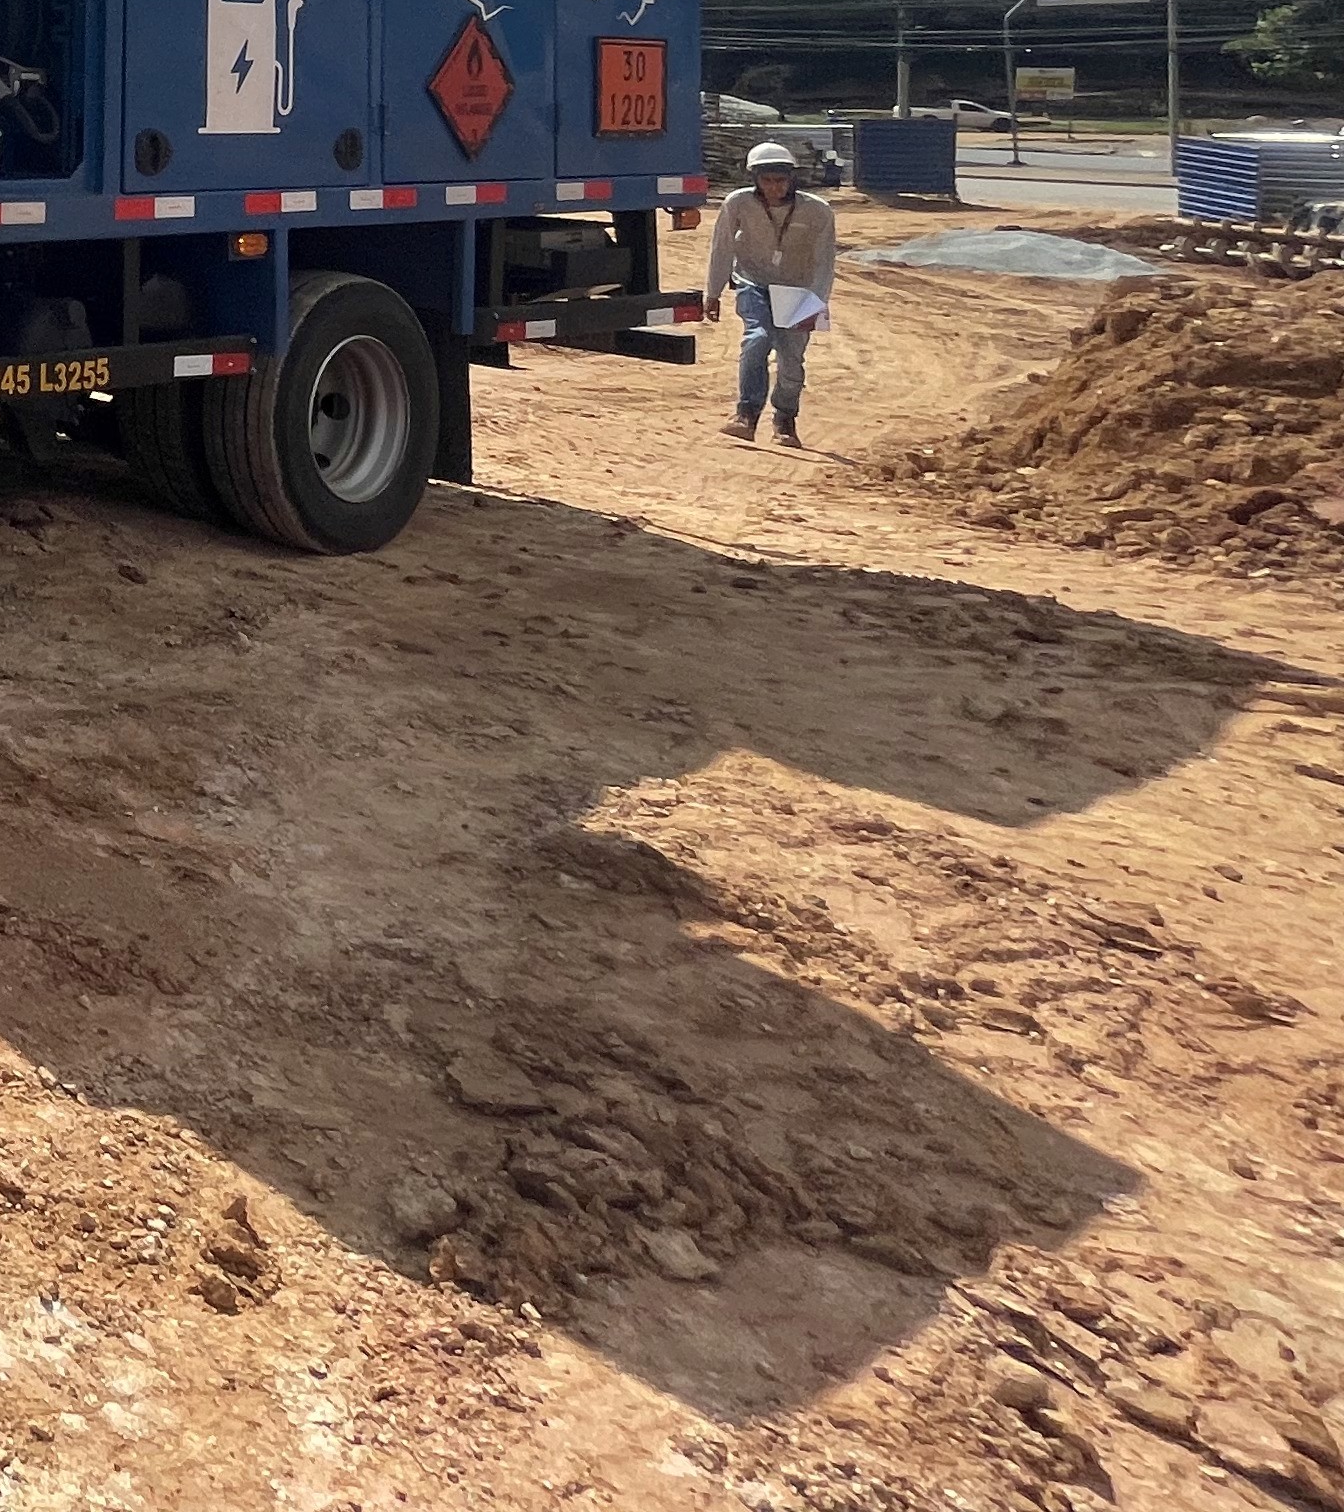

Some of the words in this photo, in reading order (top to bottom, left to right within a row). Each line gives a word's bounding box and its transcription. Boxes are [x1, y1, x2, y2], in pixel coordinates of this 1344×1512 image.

[623, 51, 647, 83] 30
[610, 94, 658, 126] 1202
[40, 357, 109, 392] L3255
